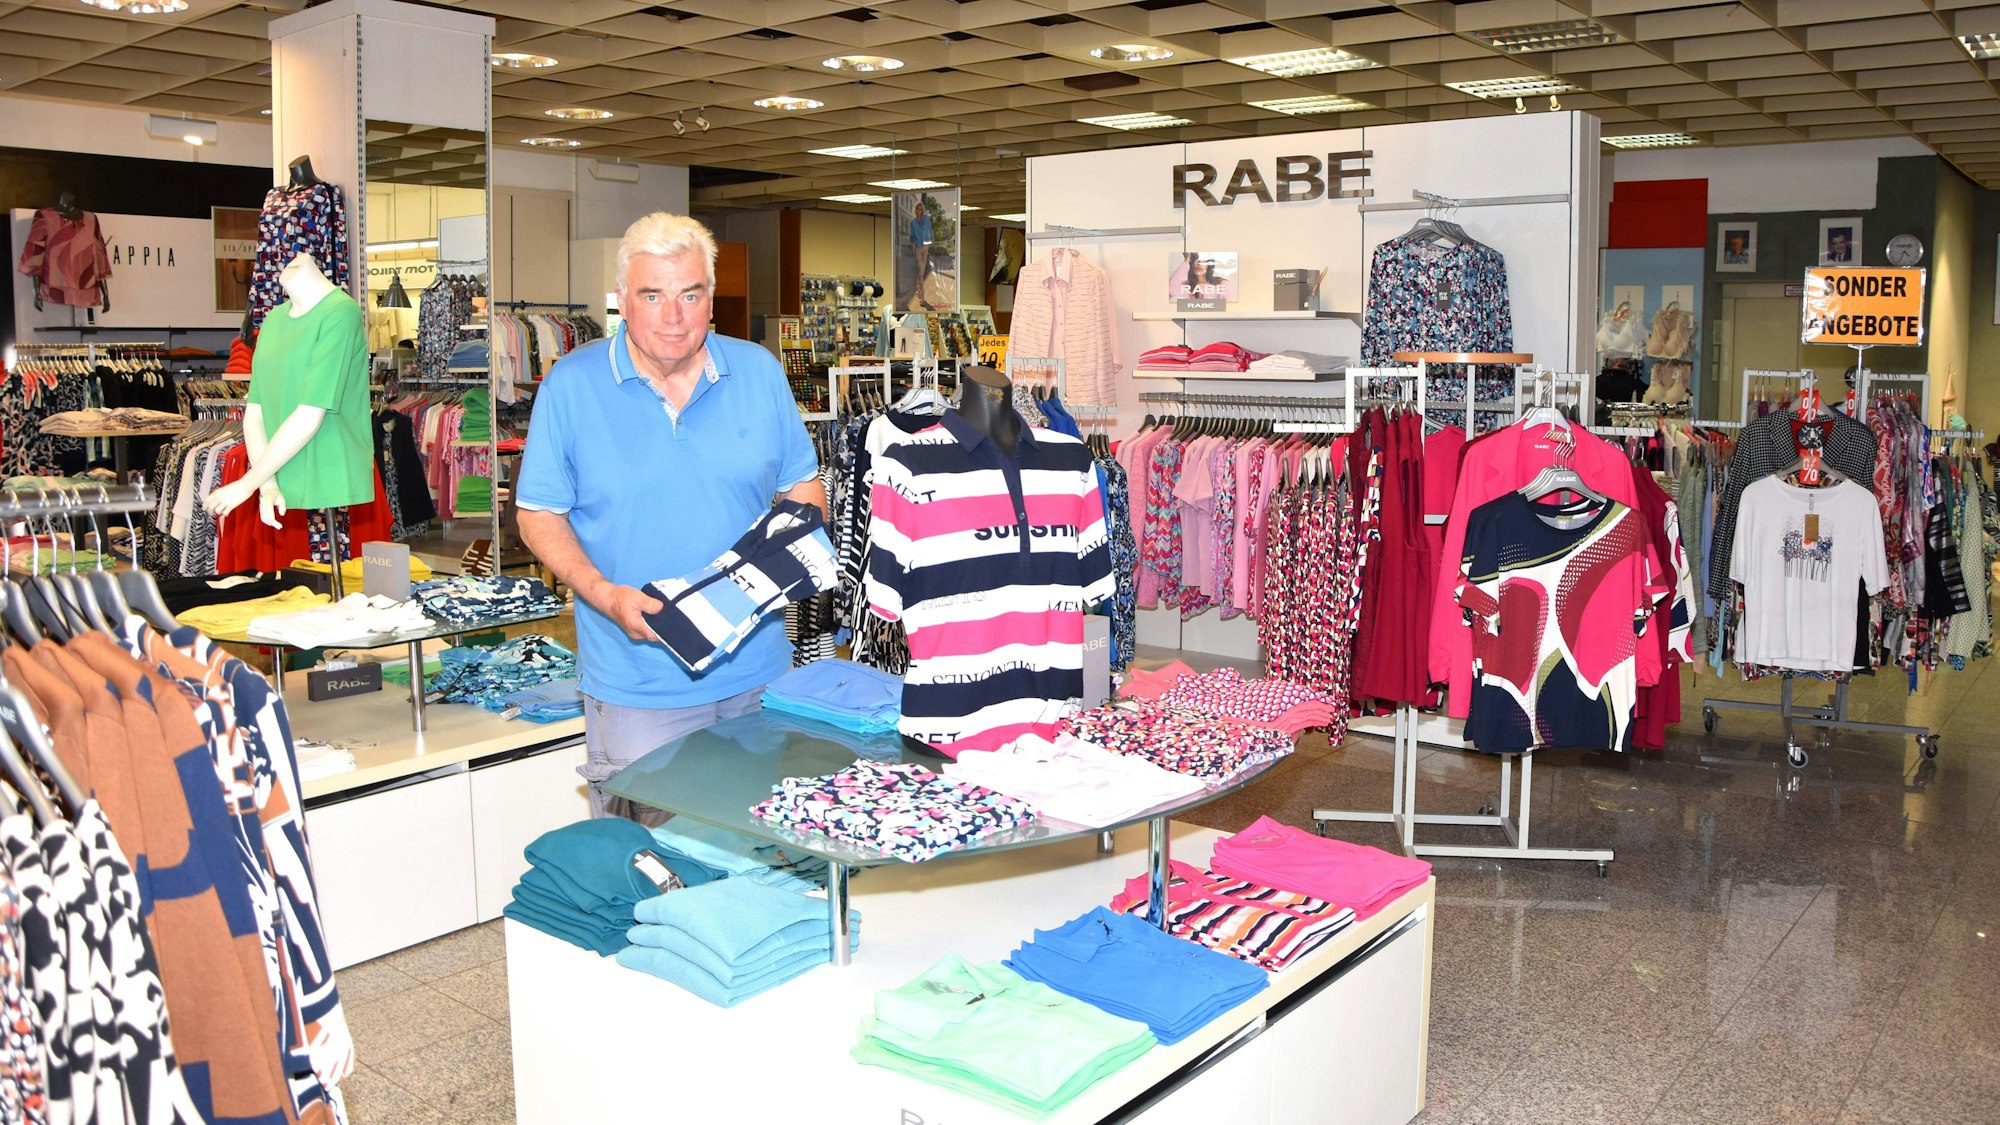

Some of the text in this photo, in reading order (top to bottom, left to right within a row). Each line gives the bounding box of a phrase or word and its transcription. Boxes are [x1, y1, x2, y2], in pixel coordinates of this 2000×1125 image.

[1173, 150, 1374, 208] RABE
[1180, 284, 1227, 295] RABE
[1824, 276, 1907, 297] SONDER
[980, 339, 1006, 347] Jedes
[363, 555, 393, 567] RABE
